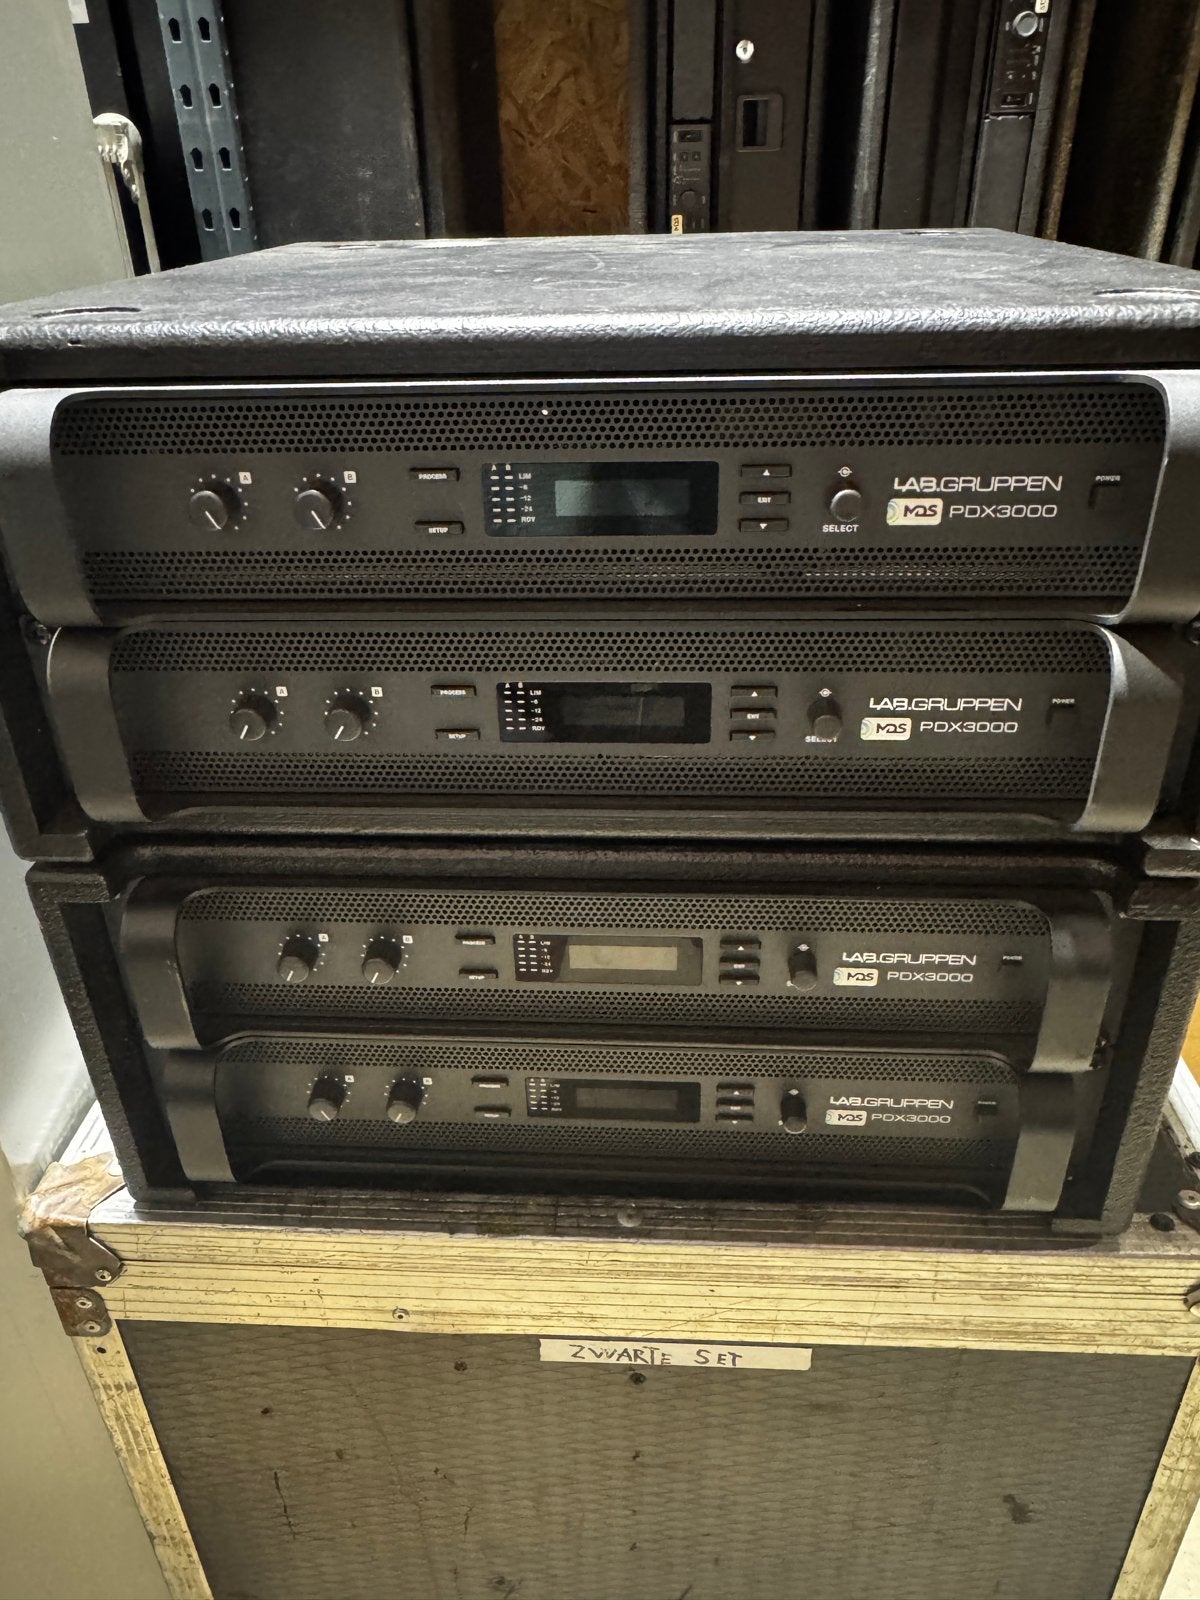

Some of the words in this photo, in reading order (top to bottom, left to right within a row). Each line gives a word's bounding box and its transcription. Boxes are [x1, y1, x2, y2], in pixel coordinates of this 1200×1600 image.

[893, 475, 1063, 492] LAB.GRUPPEN
[903, 504, 938, 518] MDS
[949, 504, 1058, 518] PDX3000
[822, 524, 860, 533] SELECT
[869, 697, 1023, 712] LAB.GRUPPEN
[875, 723, 908, 734] MDS
[919, 721, 1019, 733] PDX3000
[841, 952, 977, 966] LAB.GRUPPEN
[887, 971, 974, 983] PDX3000
[829, 1096, 954, 1109] LAB.GRUPPEN
[870, 1113, 951, 1124] PDX3000
[568, 1344, 672, 1366] ZWARTE
[694, 1349, 743, 1367] SET
